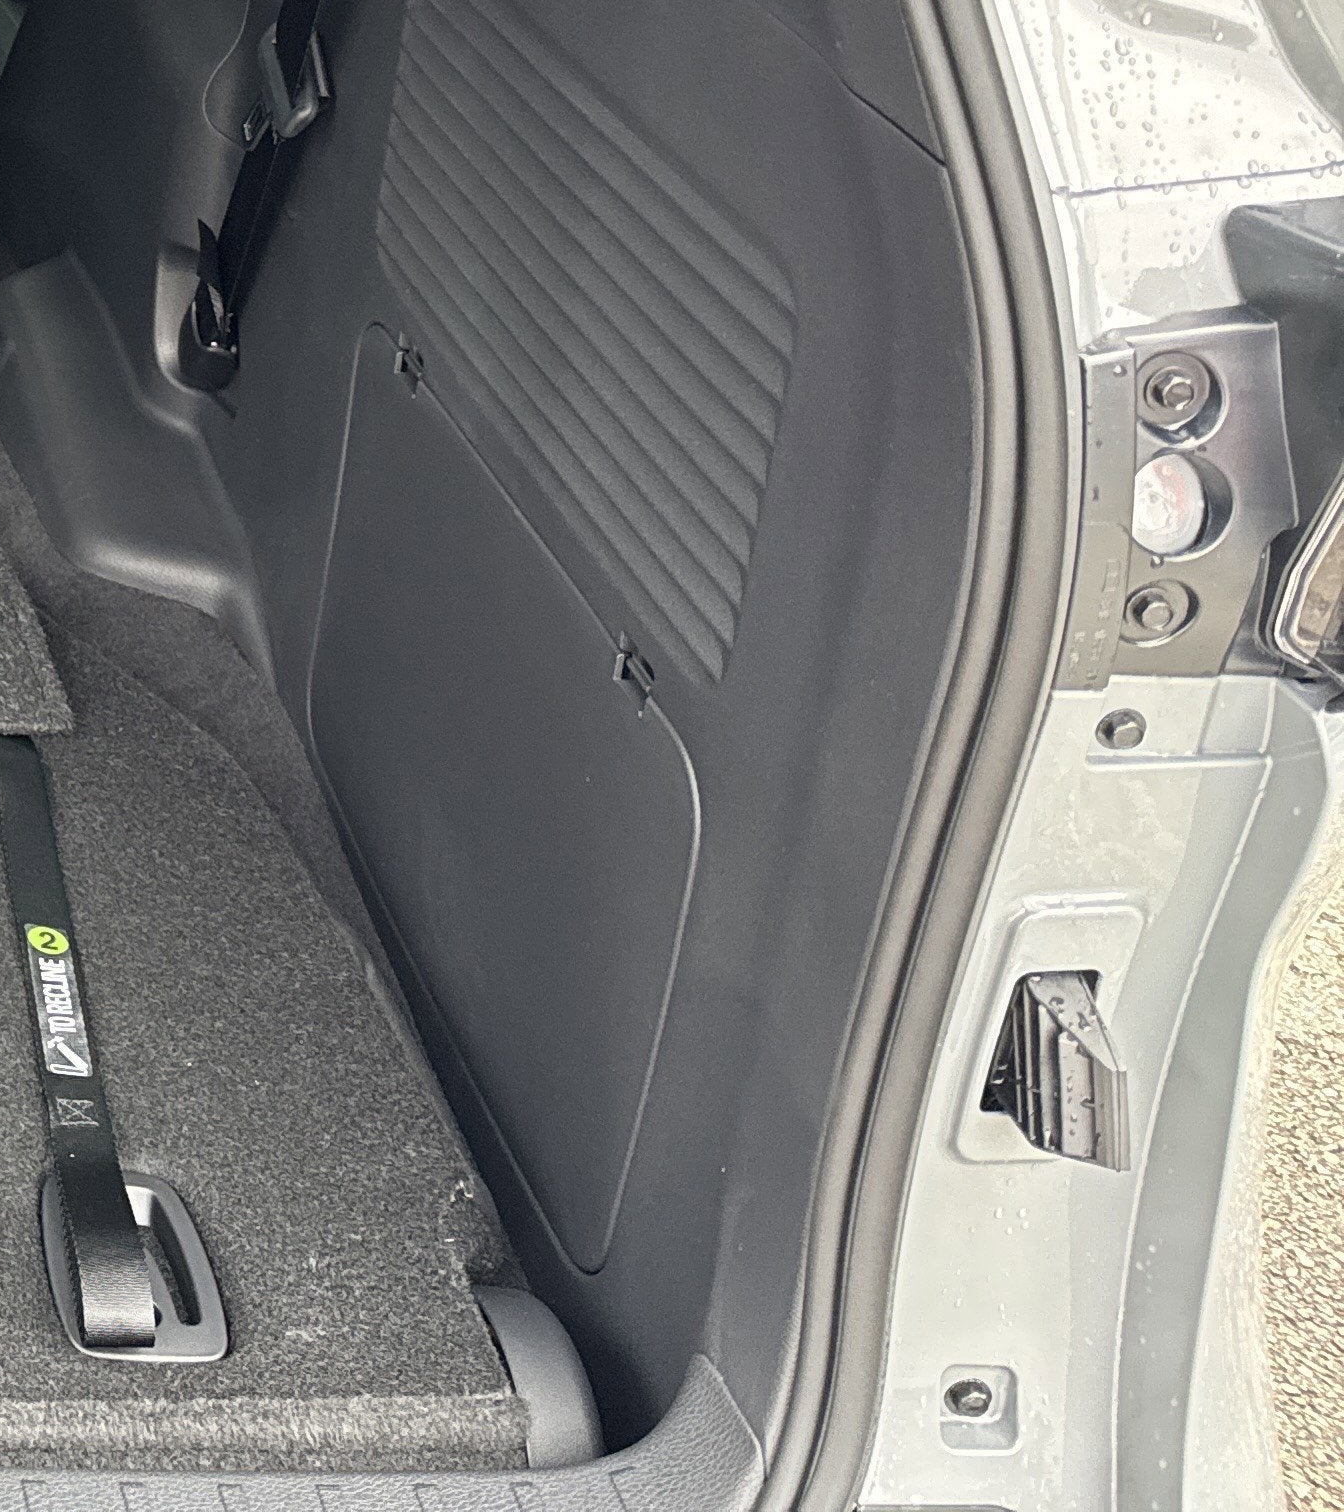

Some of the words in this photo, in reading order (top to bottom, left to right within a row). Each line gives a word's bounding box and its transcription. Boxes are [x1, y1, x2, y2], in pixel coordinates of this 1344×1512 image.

[38, 931, 59, 951] 2
[38, 956, 74, 1016] RECLINE
[47, 1016, 77, 1034] TO
